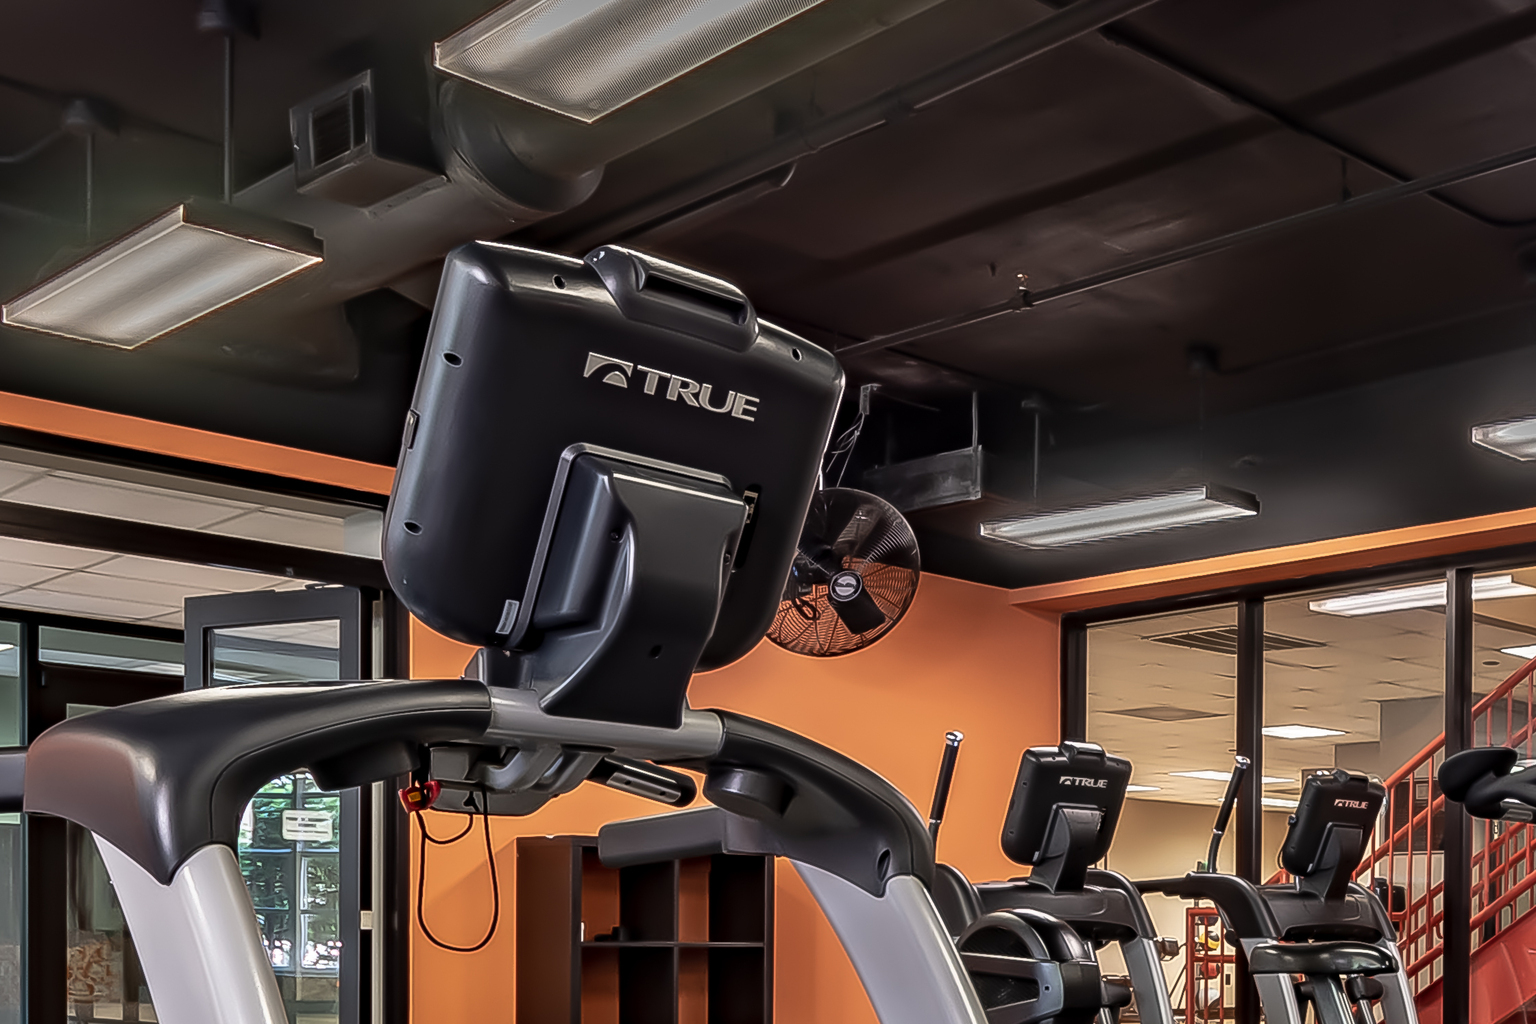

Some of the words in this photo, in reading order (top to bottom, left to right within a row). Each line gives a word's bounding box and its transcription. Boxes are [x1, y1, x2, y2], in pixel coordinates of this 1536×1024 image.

[636, 364, 760, 422] TRUE
[1073, 776, 1108, 788] TRUE
[1344, 800, 1369, 809] TRUE
